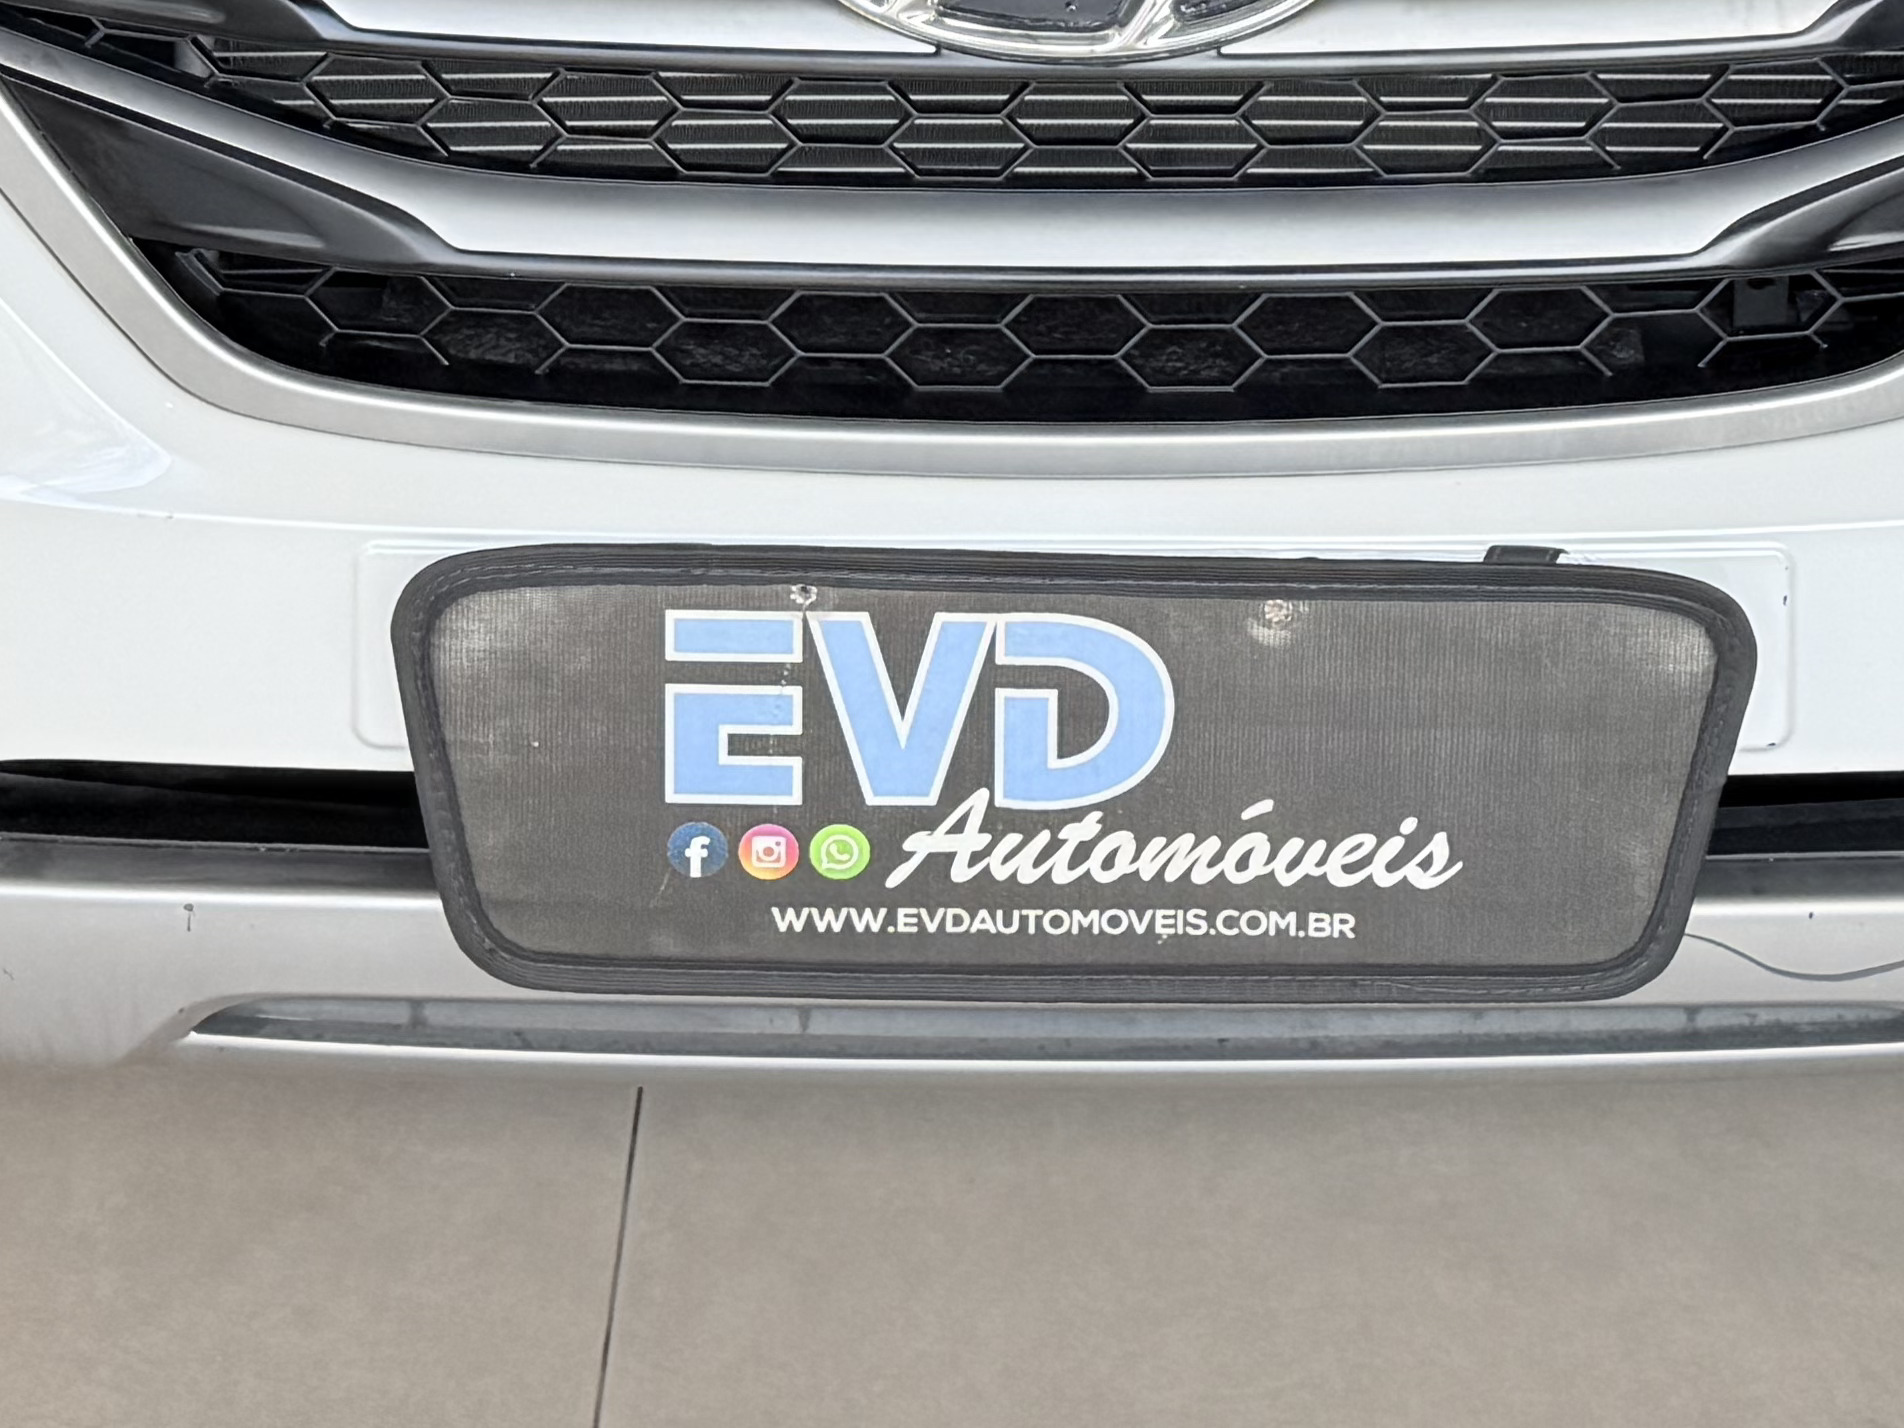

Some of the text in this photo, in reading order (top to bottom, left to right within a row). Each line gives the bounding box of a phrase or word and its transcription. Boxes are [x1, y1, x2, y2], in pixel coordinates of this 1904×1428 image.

[665, 609, 1175, 810] EVD
[886, 787, 1463, 890] Automóveis
[772, 905, 1356, 940] WWW.EVDAUTOMOVEIS.COM.BR
